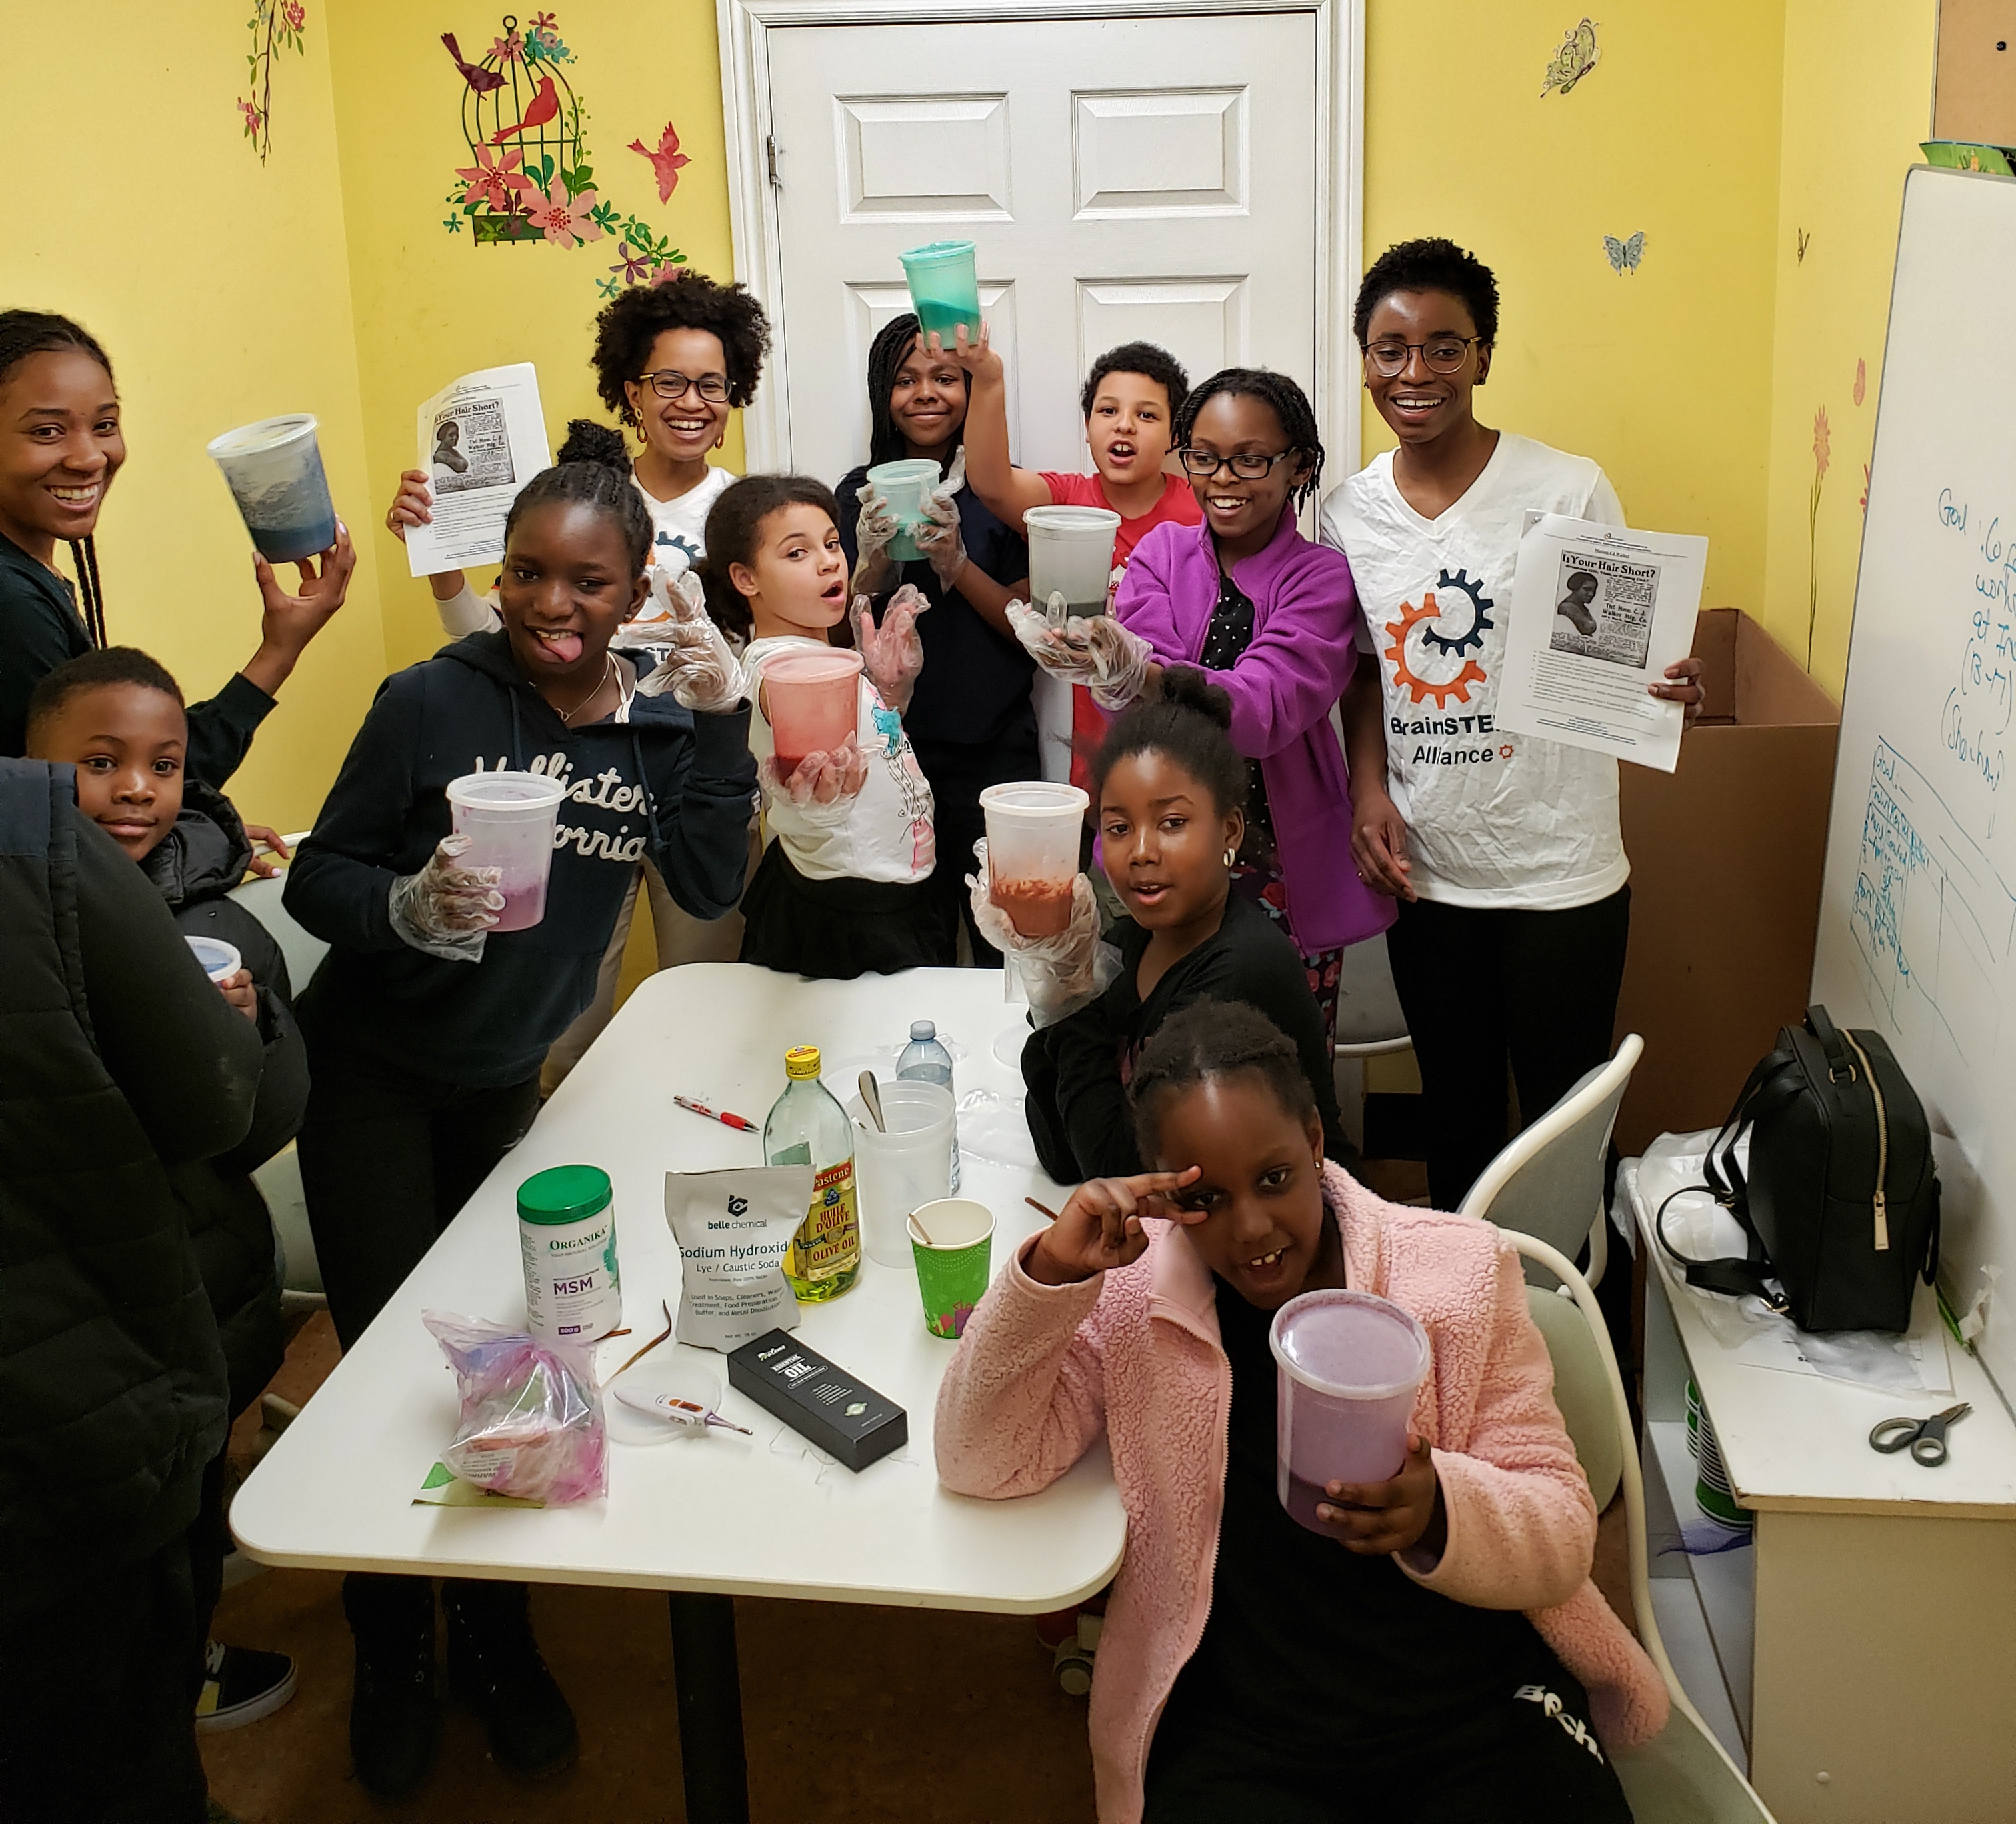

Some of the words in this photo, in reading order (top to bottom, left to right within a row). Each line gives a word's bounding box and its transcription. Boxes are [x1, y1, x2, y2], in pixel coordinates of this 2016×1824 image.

[438, 411, 454, 421] Your
[455, 407, 471, 415] Hair
[472, 401, 499, 411] Short?
[1562, 553, 1570, 563] Is
[1571, 555, 1597, 568] Your
[1599, 561, 1619, 572] Hair
[1621, 565, 1656, 578] Short?
[1391, 715, 1496, 735] BrainSTE
[1412, 745, 1493, 765] Alliance
[816, 1210, 850, 1233] D'OLIVE
[820, 1203, 846, 1222] HUILE
[707, 1221, 730, 1229] belle
[731, 1219, 767, 1229] chemical
[679, 1246, 725, 1258] Sodium
[730, 1241, 789, 1259] Hydroxid
[813, 1243, 840, 1261] OLIVE
[842, 1236, 855, 1250] OIL
[697, 1263, 712, 1273] Lye
[723, 1261, 755, 1273] Caustic
[758, 1259, 779, 1269] Soda
[554, 1276, 593, 1295] MSM
[784, 1362, 812, 1378] OIL
